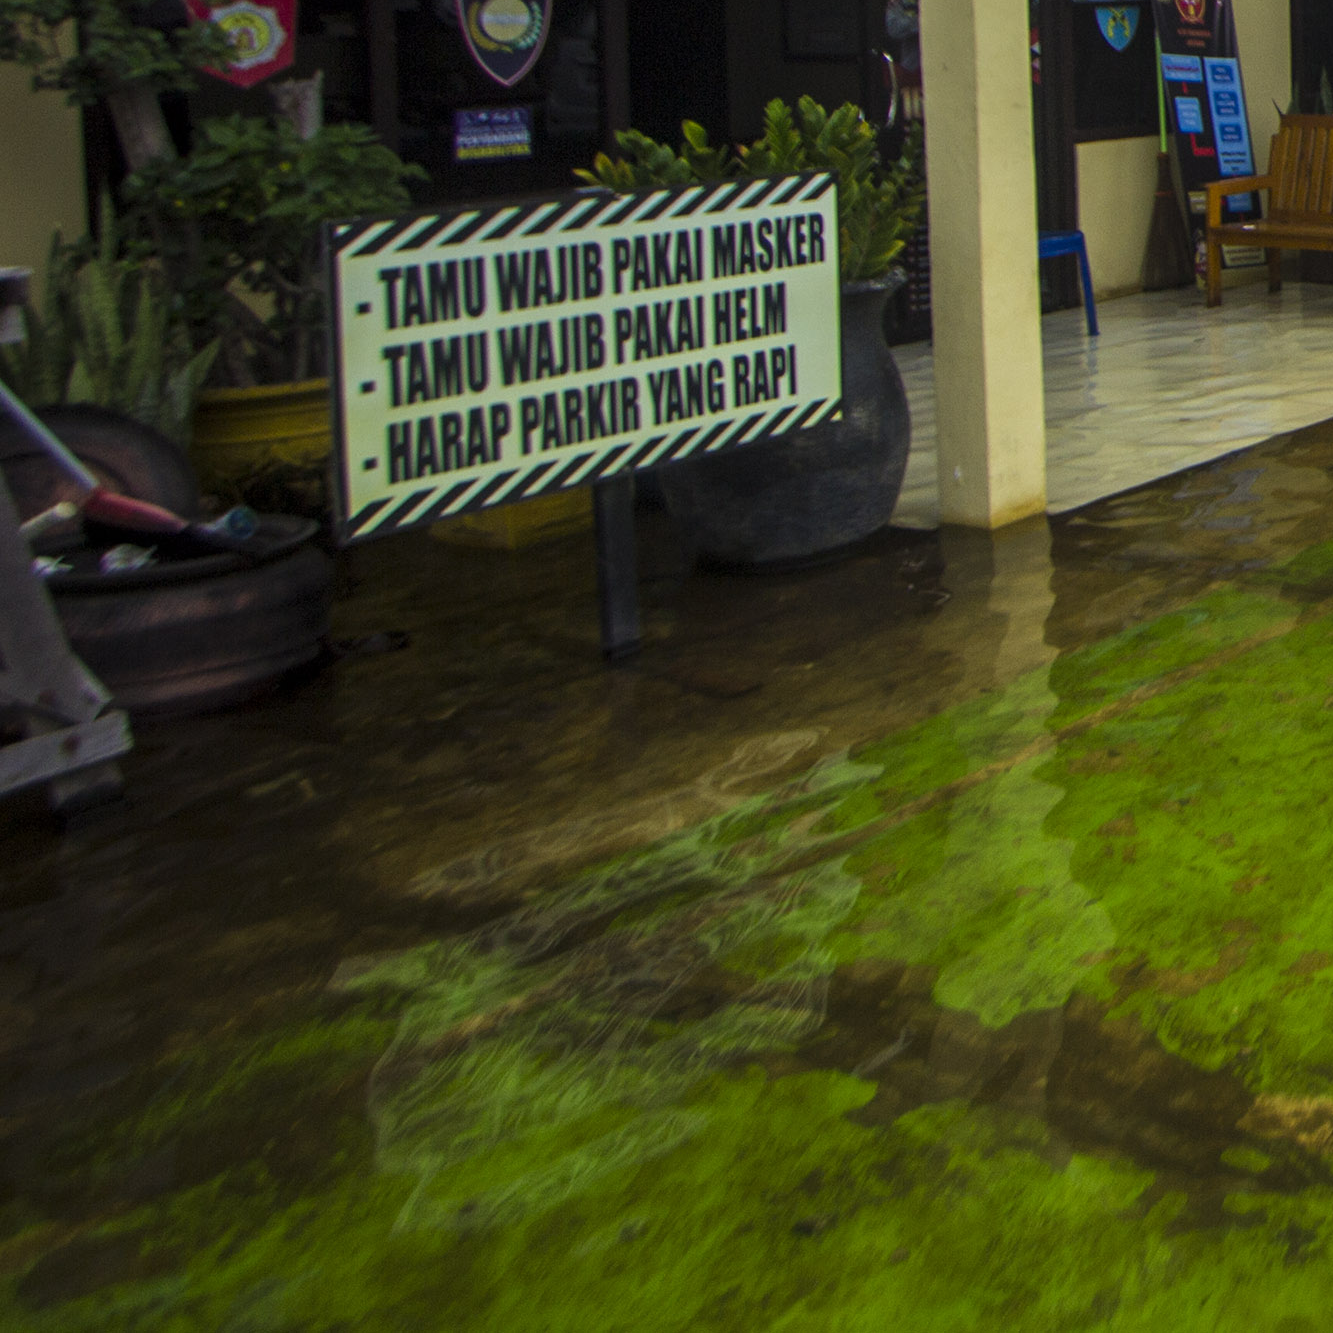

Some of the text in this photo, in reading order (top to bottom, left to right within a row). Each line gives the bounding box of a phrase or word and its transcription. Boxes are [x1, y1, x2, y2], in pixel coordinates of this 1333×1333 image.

[378, 212, 825, 330] TAMU WAJIB PAKAI MASKER
[382, 282, 787, 408] TAMU WAJIB PAKAI HELM
[386, 345, 798, 484] HARAP PARKIR YANG RAPI
